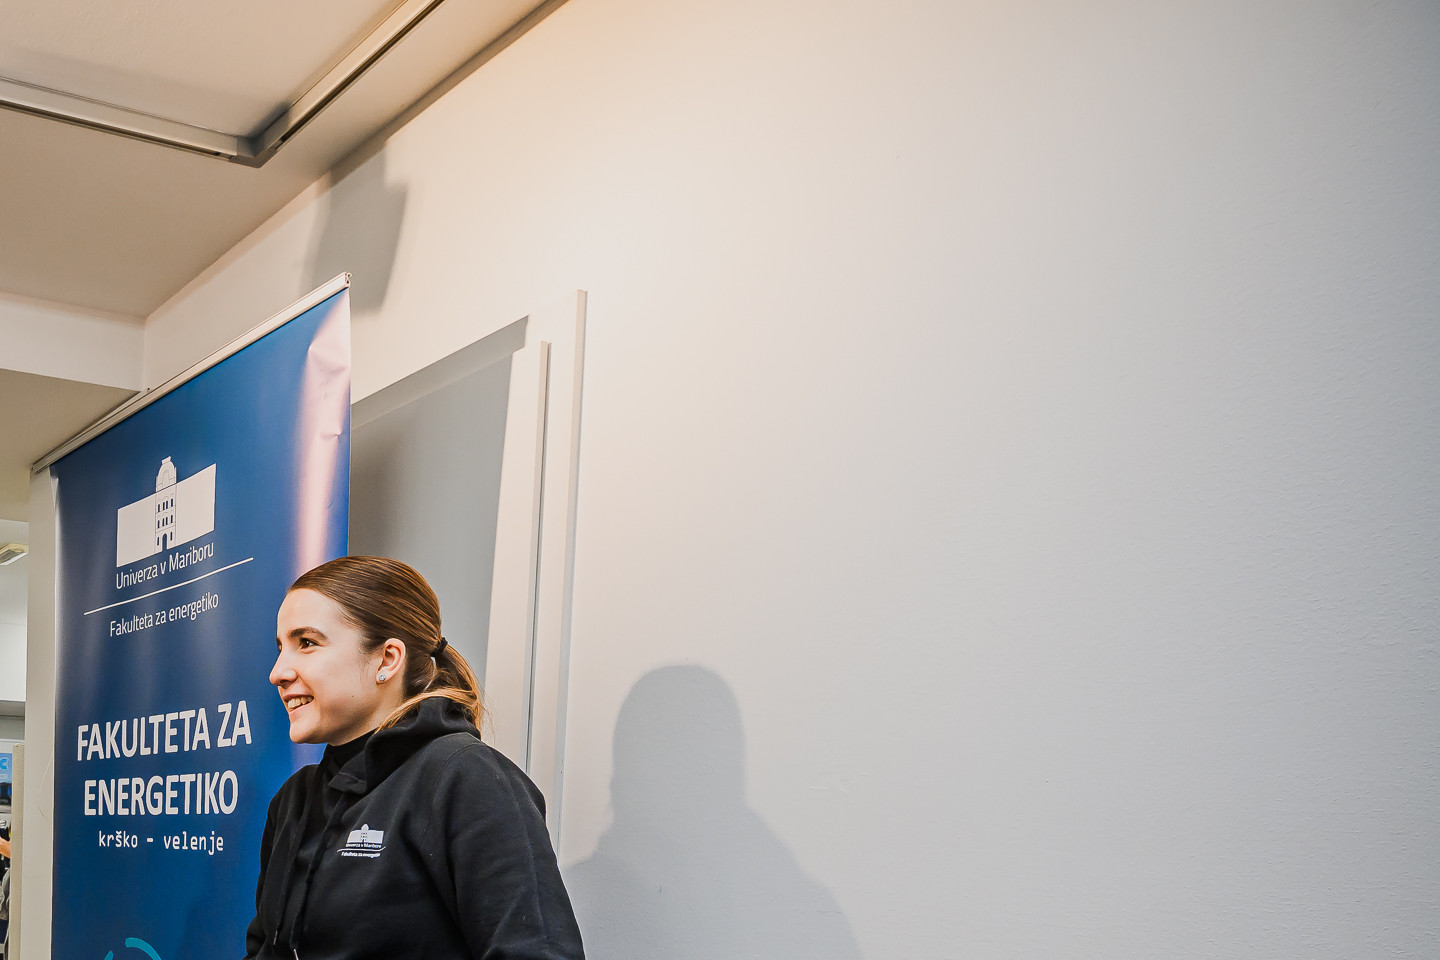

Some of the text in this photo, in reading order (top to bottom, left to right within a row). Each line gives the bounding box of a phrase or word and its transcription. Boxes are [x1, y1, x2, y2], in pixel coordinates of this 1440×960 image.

[116, 542, 214, 590] Univerza v Mariboru
[110, 592, 219, 637] Fakulteta za energetiko
[77, 700, 252, 761] FAKULTETA ZA
[84, 770, 239, 816] ENERGETIKO
[98, 831, 138, 848] krško
[163, 831, 224, 856] velenje
